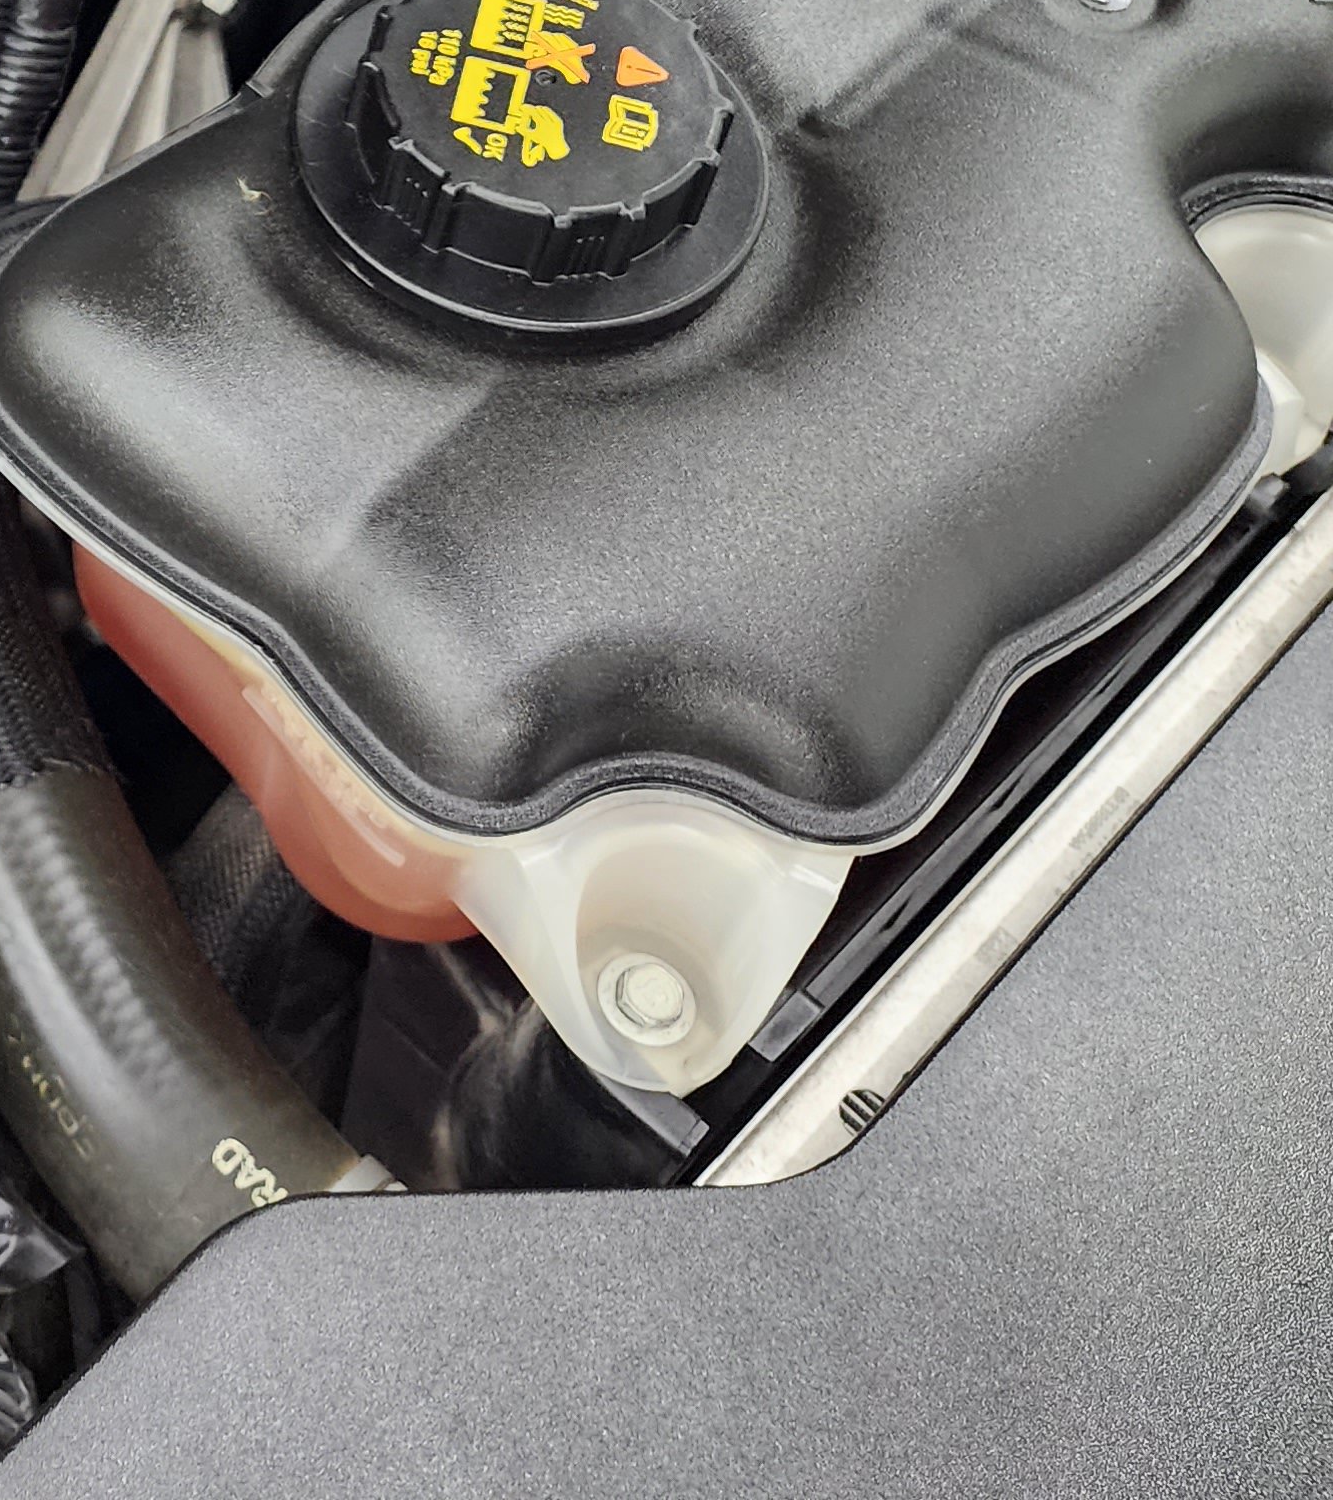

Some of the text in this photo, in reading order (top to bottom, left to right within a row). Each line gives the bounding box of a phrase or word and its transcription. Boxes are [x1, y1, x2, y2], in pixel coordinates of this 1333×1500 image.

[417, 31, 439, 51] 16
[482, 132, 509, 163] OK
[211, 1137, 289, 1208] RAD
